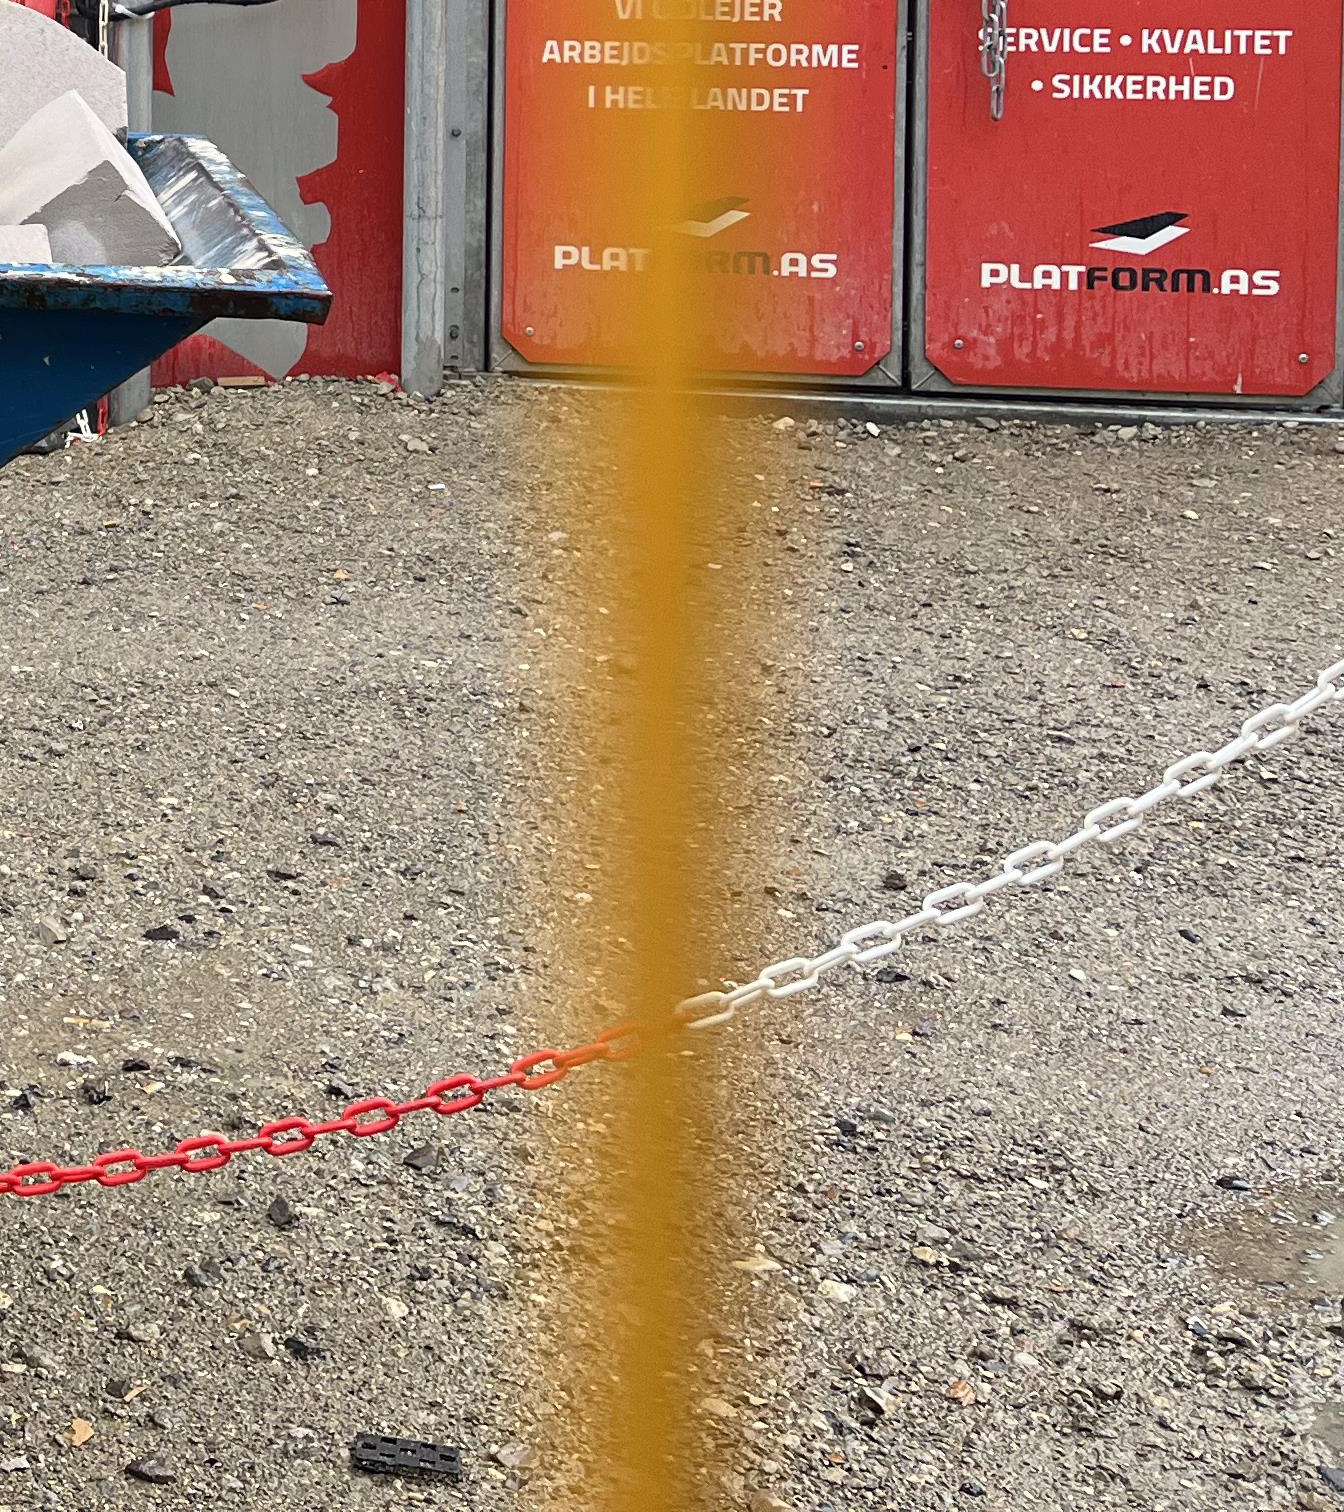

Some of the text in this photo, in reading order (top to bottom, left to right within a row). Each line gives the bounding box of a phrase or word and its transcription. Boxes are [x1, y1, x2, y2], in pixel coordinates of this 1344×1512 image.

[1140, 28, 1293, 56] KVALITET
[605, 85, 682, 110] HEL
[692, 87, 810, 113] LANDET
[1051, 73, 1235, 101] SIKKERHED
[553, 245, 838, 279] PLATRM.AS
[981, 262, 1281, 296] PLATFORM.AS
